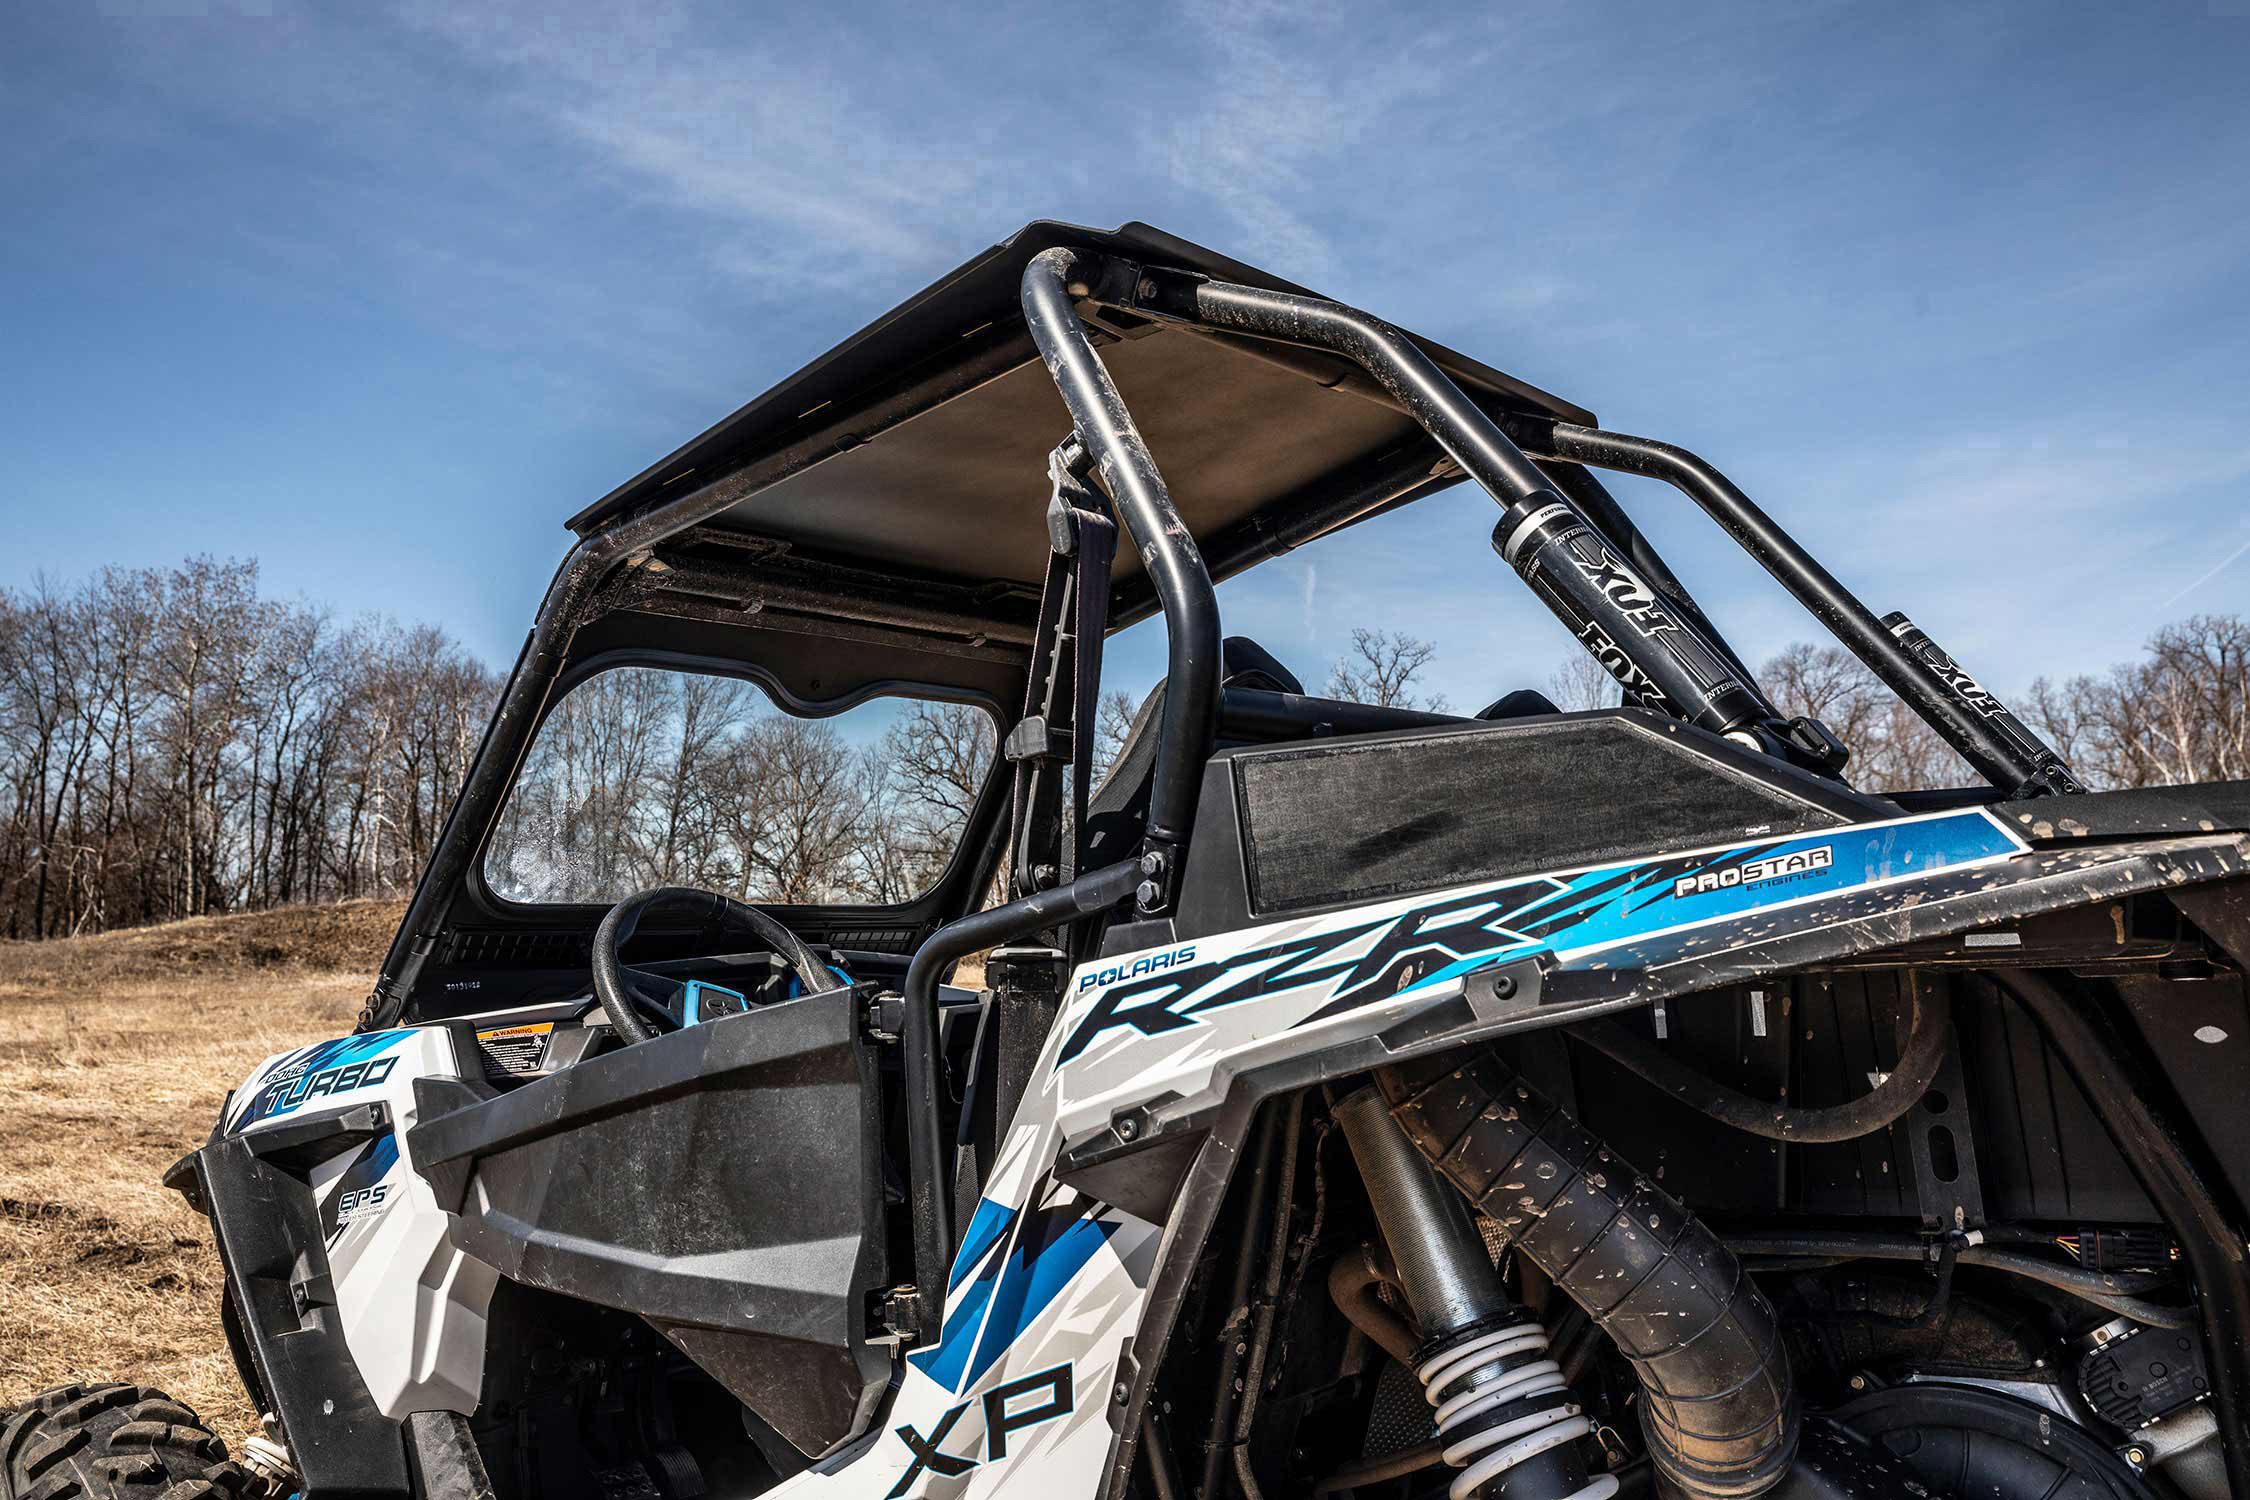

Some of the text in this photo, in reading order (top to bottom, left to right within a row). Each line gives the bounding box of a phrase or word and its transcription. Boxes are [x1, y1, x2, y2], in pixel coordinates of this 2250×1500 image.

[1574, 546, 1679, 637] FOX
[1577, 620, 1667, 714] FOX
[1675, 848, 1831, 897] PROSTAR
[1746, 869, 1828, 891] ENGINES
[1053, 879, 1554, 1073] RZR
[1078, 945, 1196, 993] POLARIS
[500, 1028, 532, 1036] WARNING
[265, 1055, 401, 1115] TURBO
[339, 1184, 388, 1212] EPS
[884, 1360, 1075, 1500] XP
